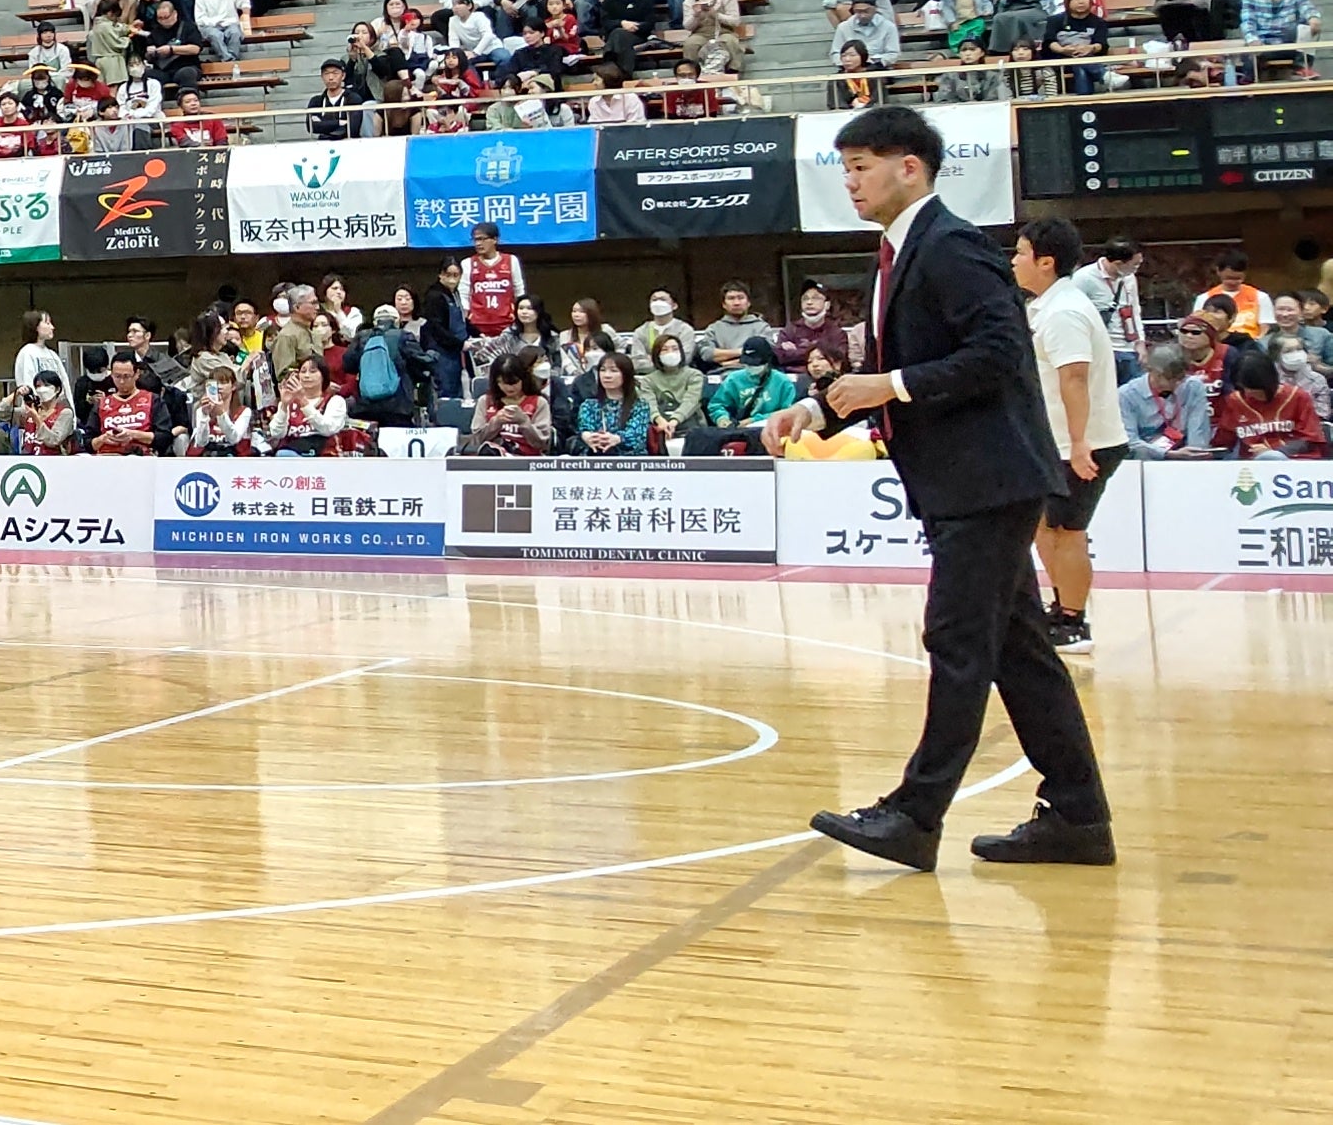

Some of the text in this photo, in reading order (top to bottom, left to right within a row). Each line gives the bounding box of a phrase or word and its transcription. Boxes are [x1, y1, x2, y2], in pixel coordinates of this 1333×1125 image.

[614, 142, 777, 161] AFTER SPORTS SOAP
[1254, 169, 1313, 182] CITIZEN
[194, 152, 209, 251] スポーツクラブ
[210, 152, 226, 251] 新時代の
[290, 190, 340, 202] WAKOKAI
[687, 193, 751, 209] フェニックス
[414, 198, 446, 214] 学校
[449, 191, 588, 228] 栗岡学園
[240, 213, 396, 242] 阪奈中央病院
[415, 214, 447, 229] 法人
[106, 235, 160, 250] ZeloFit
[485, 295, 499, 309] 14
[529, 460, 685, 472] good teeth are our passion
[231, 476, 327, 491] 未来への創造
[232, 497, 424, 517] 株式会社 日電鉄工所
[171, 531, 245, 543] NICHIDEN
[253, 532, 290, 544] IRON
[299, 533, 352, 544] WORKS
[520, 547, 707, 561] TOMIMORI DENTAL CLINIC
